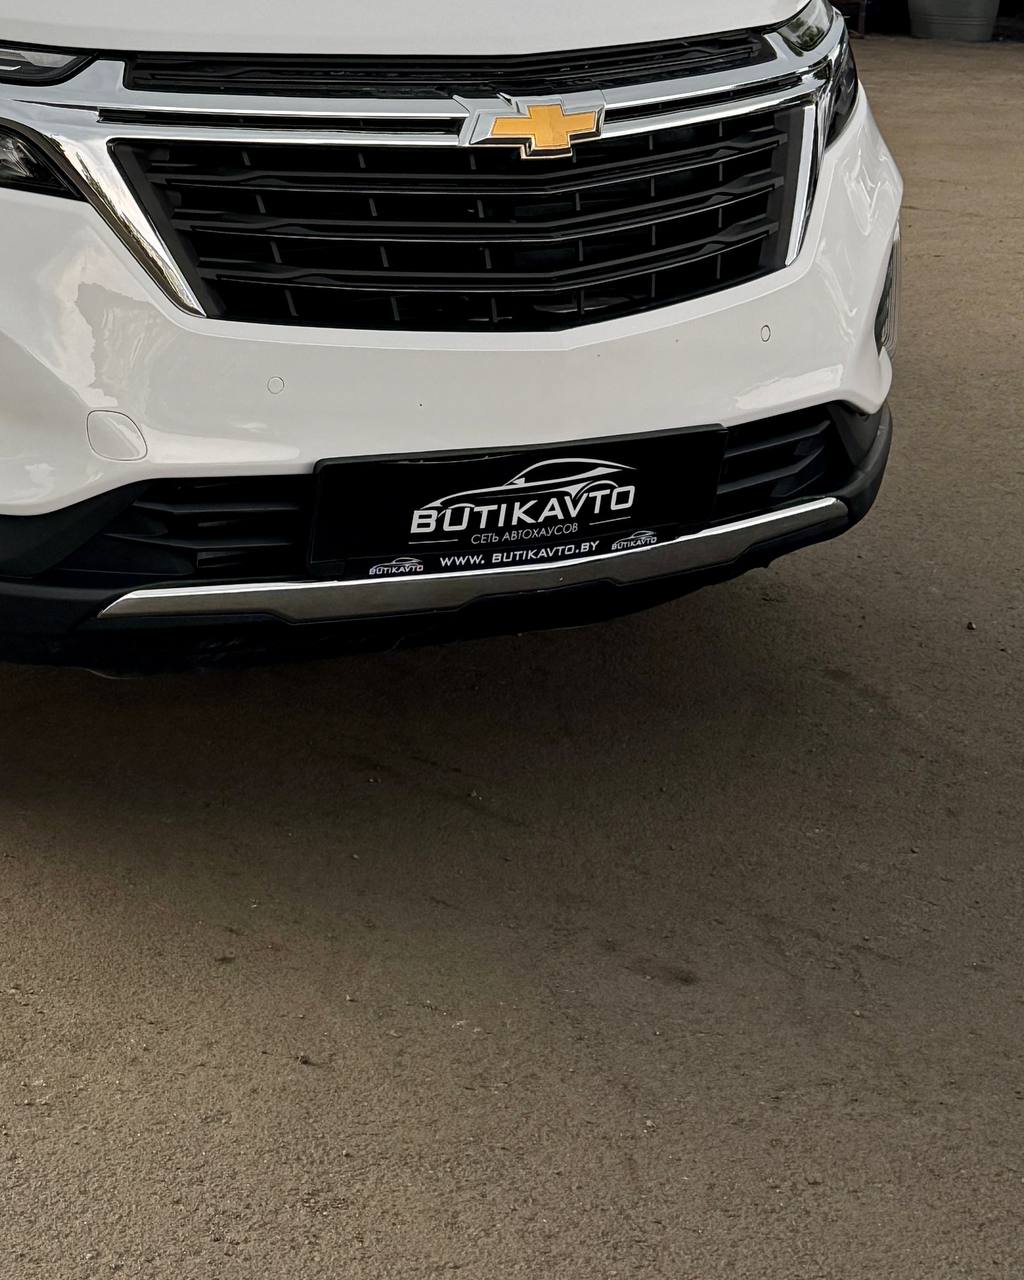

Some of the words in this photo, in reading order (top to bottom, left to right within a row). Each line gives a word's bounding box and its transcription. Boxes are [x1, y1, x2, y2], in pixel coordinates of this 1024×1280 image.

[410, 485, 636, 534] BUTIKAVTO
[471, 532, 499, 545] СЕТЬ
[501, 523, 579, 542] АВТОХАУСОВ
[611, 535, 658, 551] BUTIKAVTO
[440, 554, 486, 567] WWW.
[491, 540, 601, 564] BUTIKAVTO.BY
[368, 564, 425, 576] BUTIKAVTO
